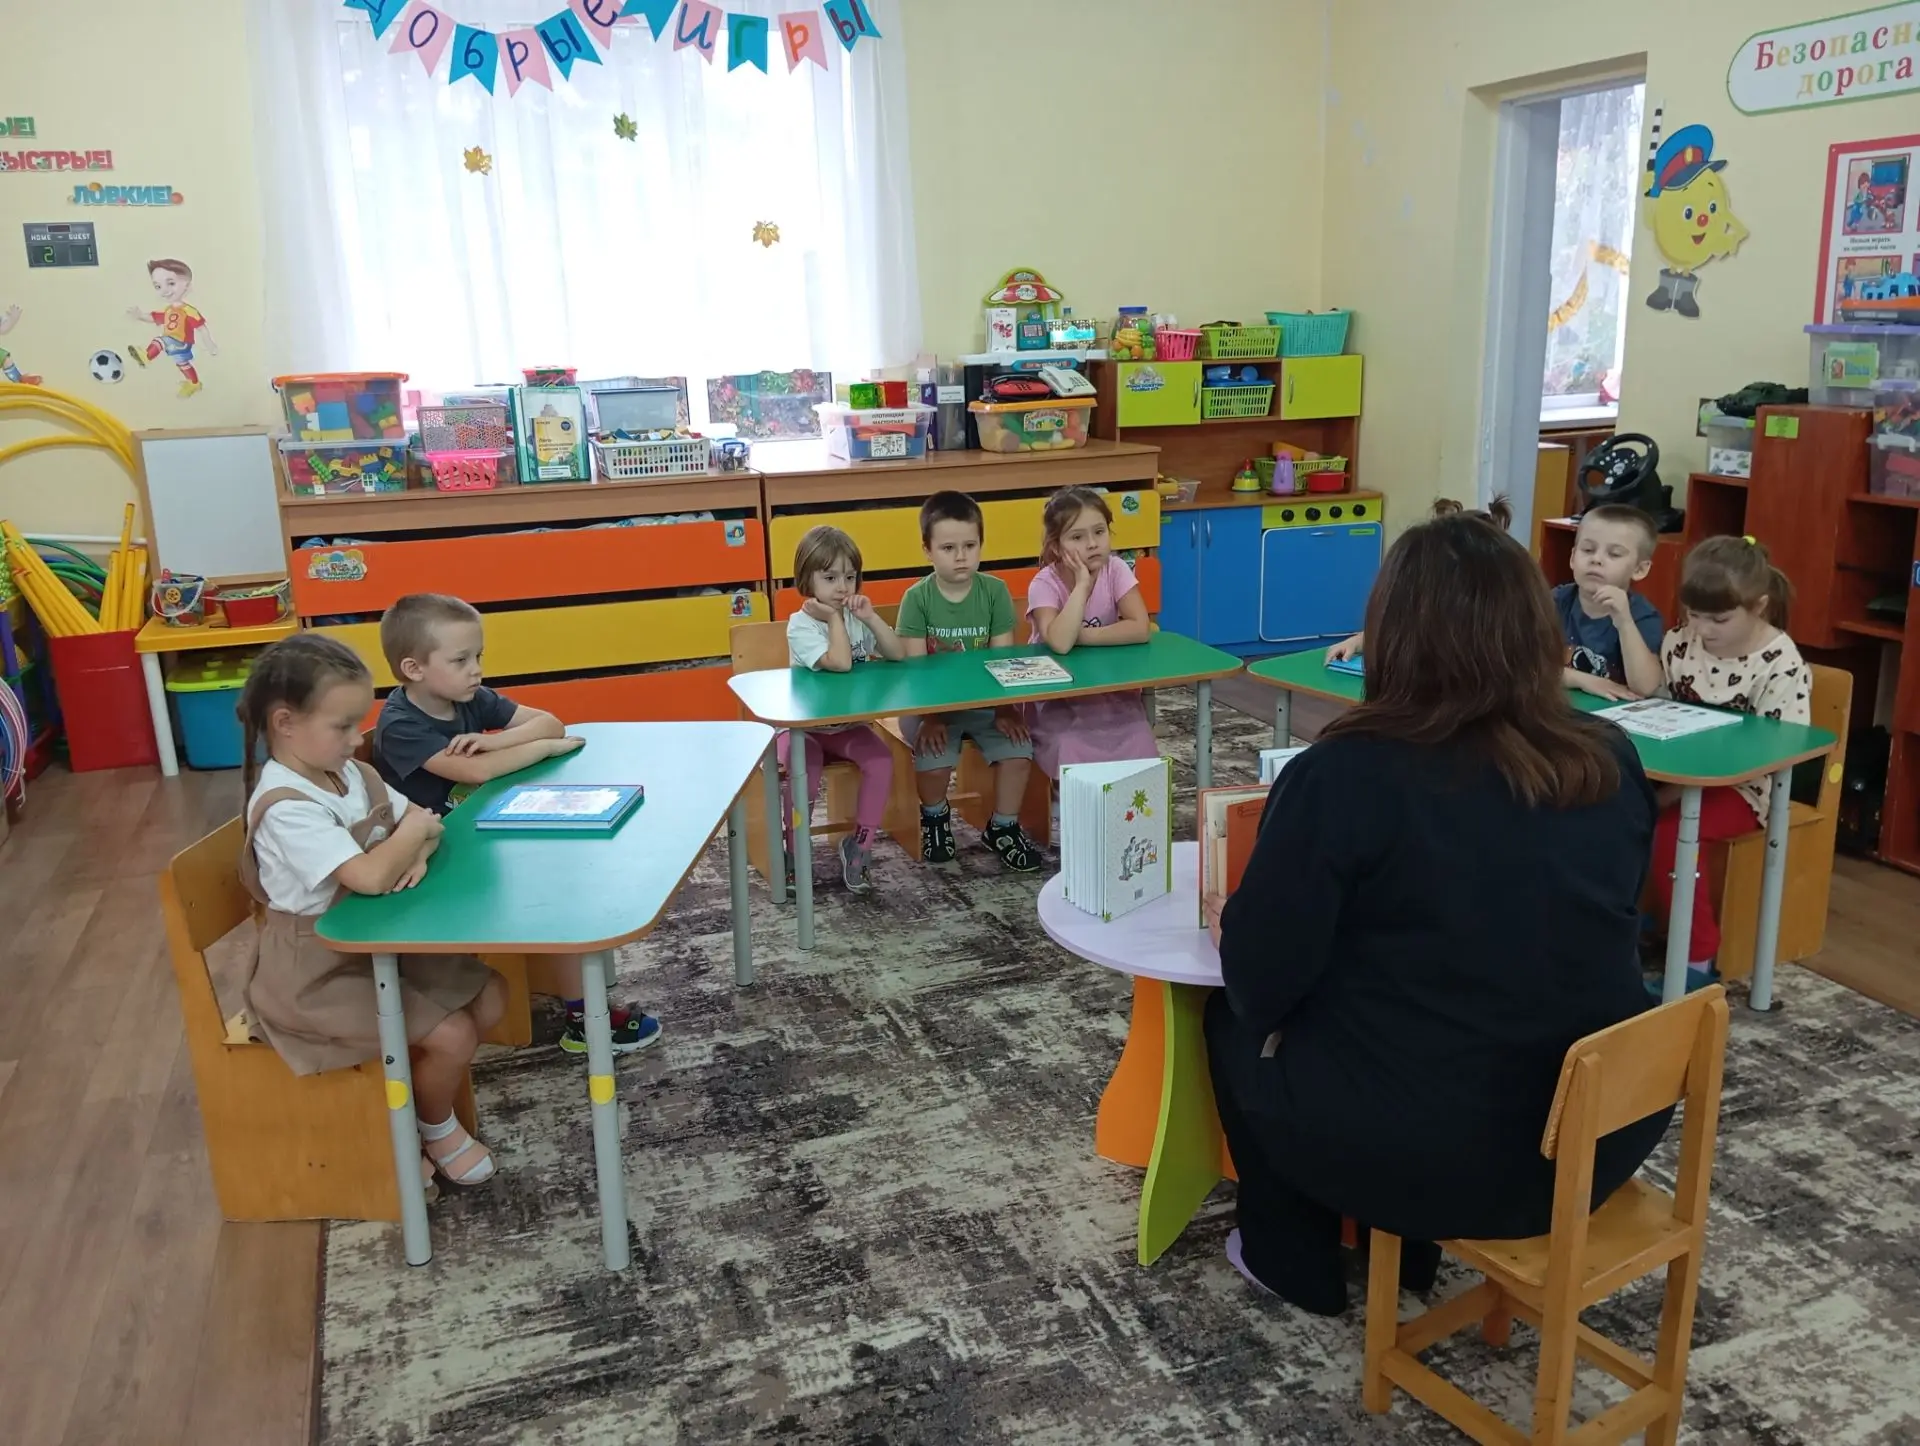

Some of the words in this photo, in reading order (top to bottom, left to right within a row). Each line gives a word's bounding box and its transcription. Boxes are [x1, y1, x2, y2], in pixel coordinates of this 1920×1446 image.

[677, 0, 866, 62] игры
[1754, 22, 1920, 71] Безопасн
[1796, 56, 1913, 98] дорога
[0, 150, 113, 170] ЫСТРЫЕ!
[73, 185, 173, 205] ЛОВКИЕ!
[44, 246, 54, 263] 2
[167, 313, 179, 331] 8
[935, 627, 951, 638] YOU
[951, 627, 978, 637] WANNA
